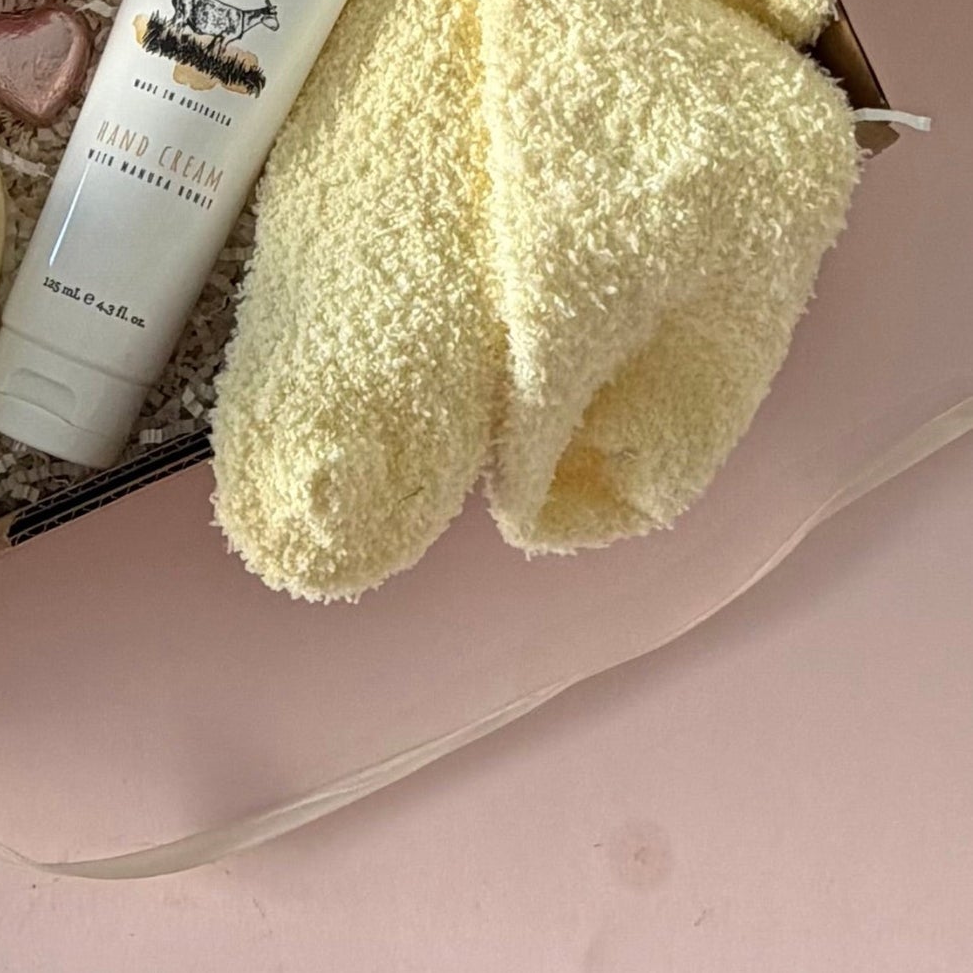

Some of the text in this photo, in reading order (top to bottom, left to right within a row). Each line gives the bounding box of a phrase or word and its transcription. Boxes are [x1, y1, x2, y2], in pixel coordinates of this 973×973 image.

[96, 120, 225, 193] HAND CREAM
[43, 276, 62, 294] 125
[61, 285, 81, 301] mL
